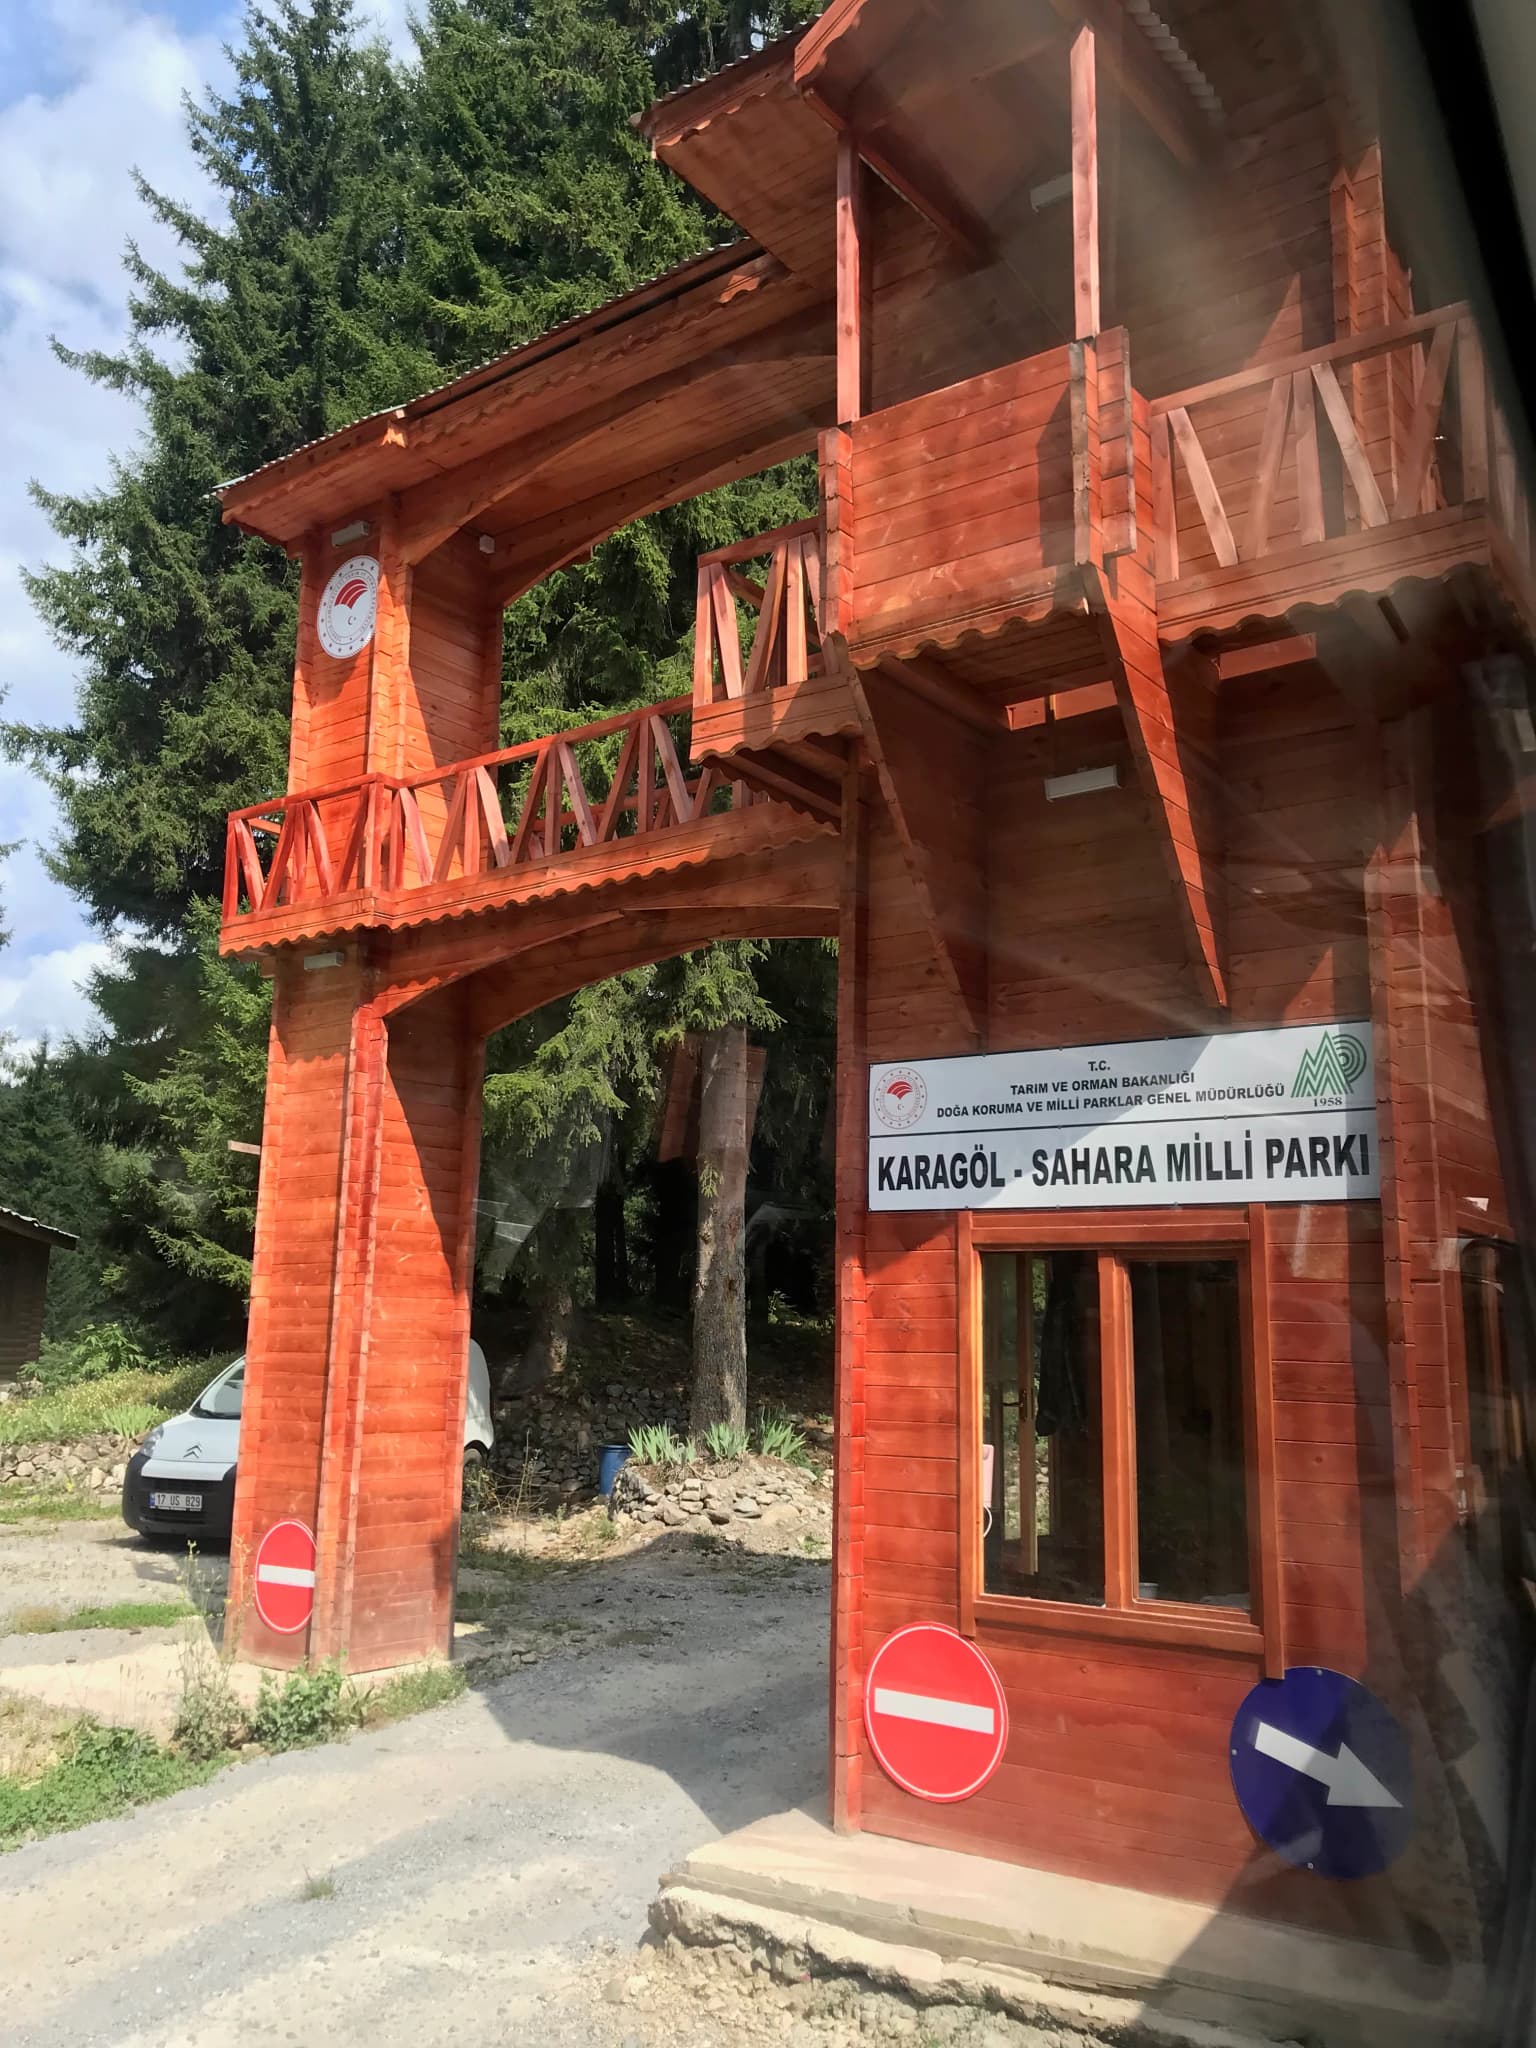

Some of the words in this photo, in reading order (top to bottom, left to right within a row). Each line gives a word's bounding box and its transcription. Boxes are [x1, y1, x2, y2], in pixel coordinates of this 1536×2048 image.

[1088, 1060, 1111, 1071] T.C.
[1010, 1083, 1048, 1095] TARIM
[1052, 1081, 1068, 1092] VE
[1072, 1078, 1118, 1091] ORMAN
[1122, 1071, 1195, 1088] BAKANLIĞI
[937, 1104, 969, 1118] DOĞA
[972, 1103, 1023, 1116] KORUMA
[1027, 1101, 1043, 1112] VE
[1046, 1097, 1080, 1111] MİLLİ
[1083, 1095, 1143, 1109] PARKLAR
[1147, 1092, 1191, 1105] GENEL
[1195, 1083, 1285, 1102] MÜDÜRLÜĞÜ
[1314, 1097, 1343, 1107] 1958
[878, 1144, 1006, 1191] KARAGÖL
[1032, 1145, 1157, 1187] SAHARA
[1166, 1130, 1253, 1182] MİLLİ
[1266, 1134, 1370, 1179] PARKI
[157, 1494, 166, 1505] 17
